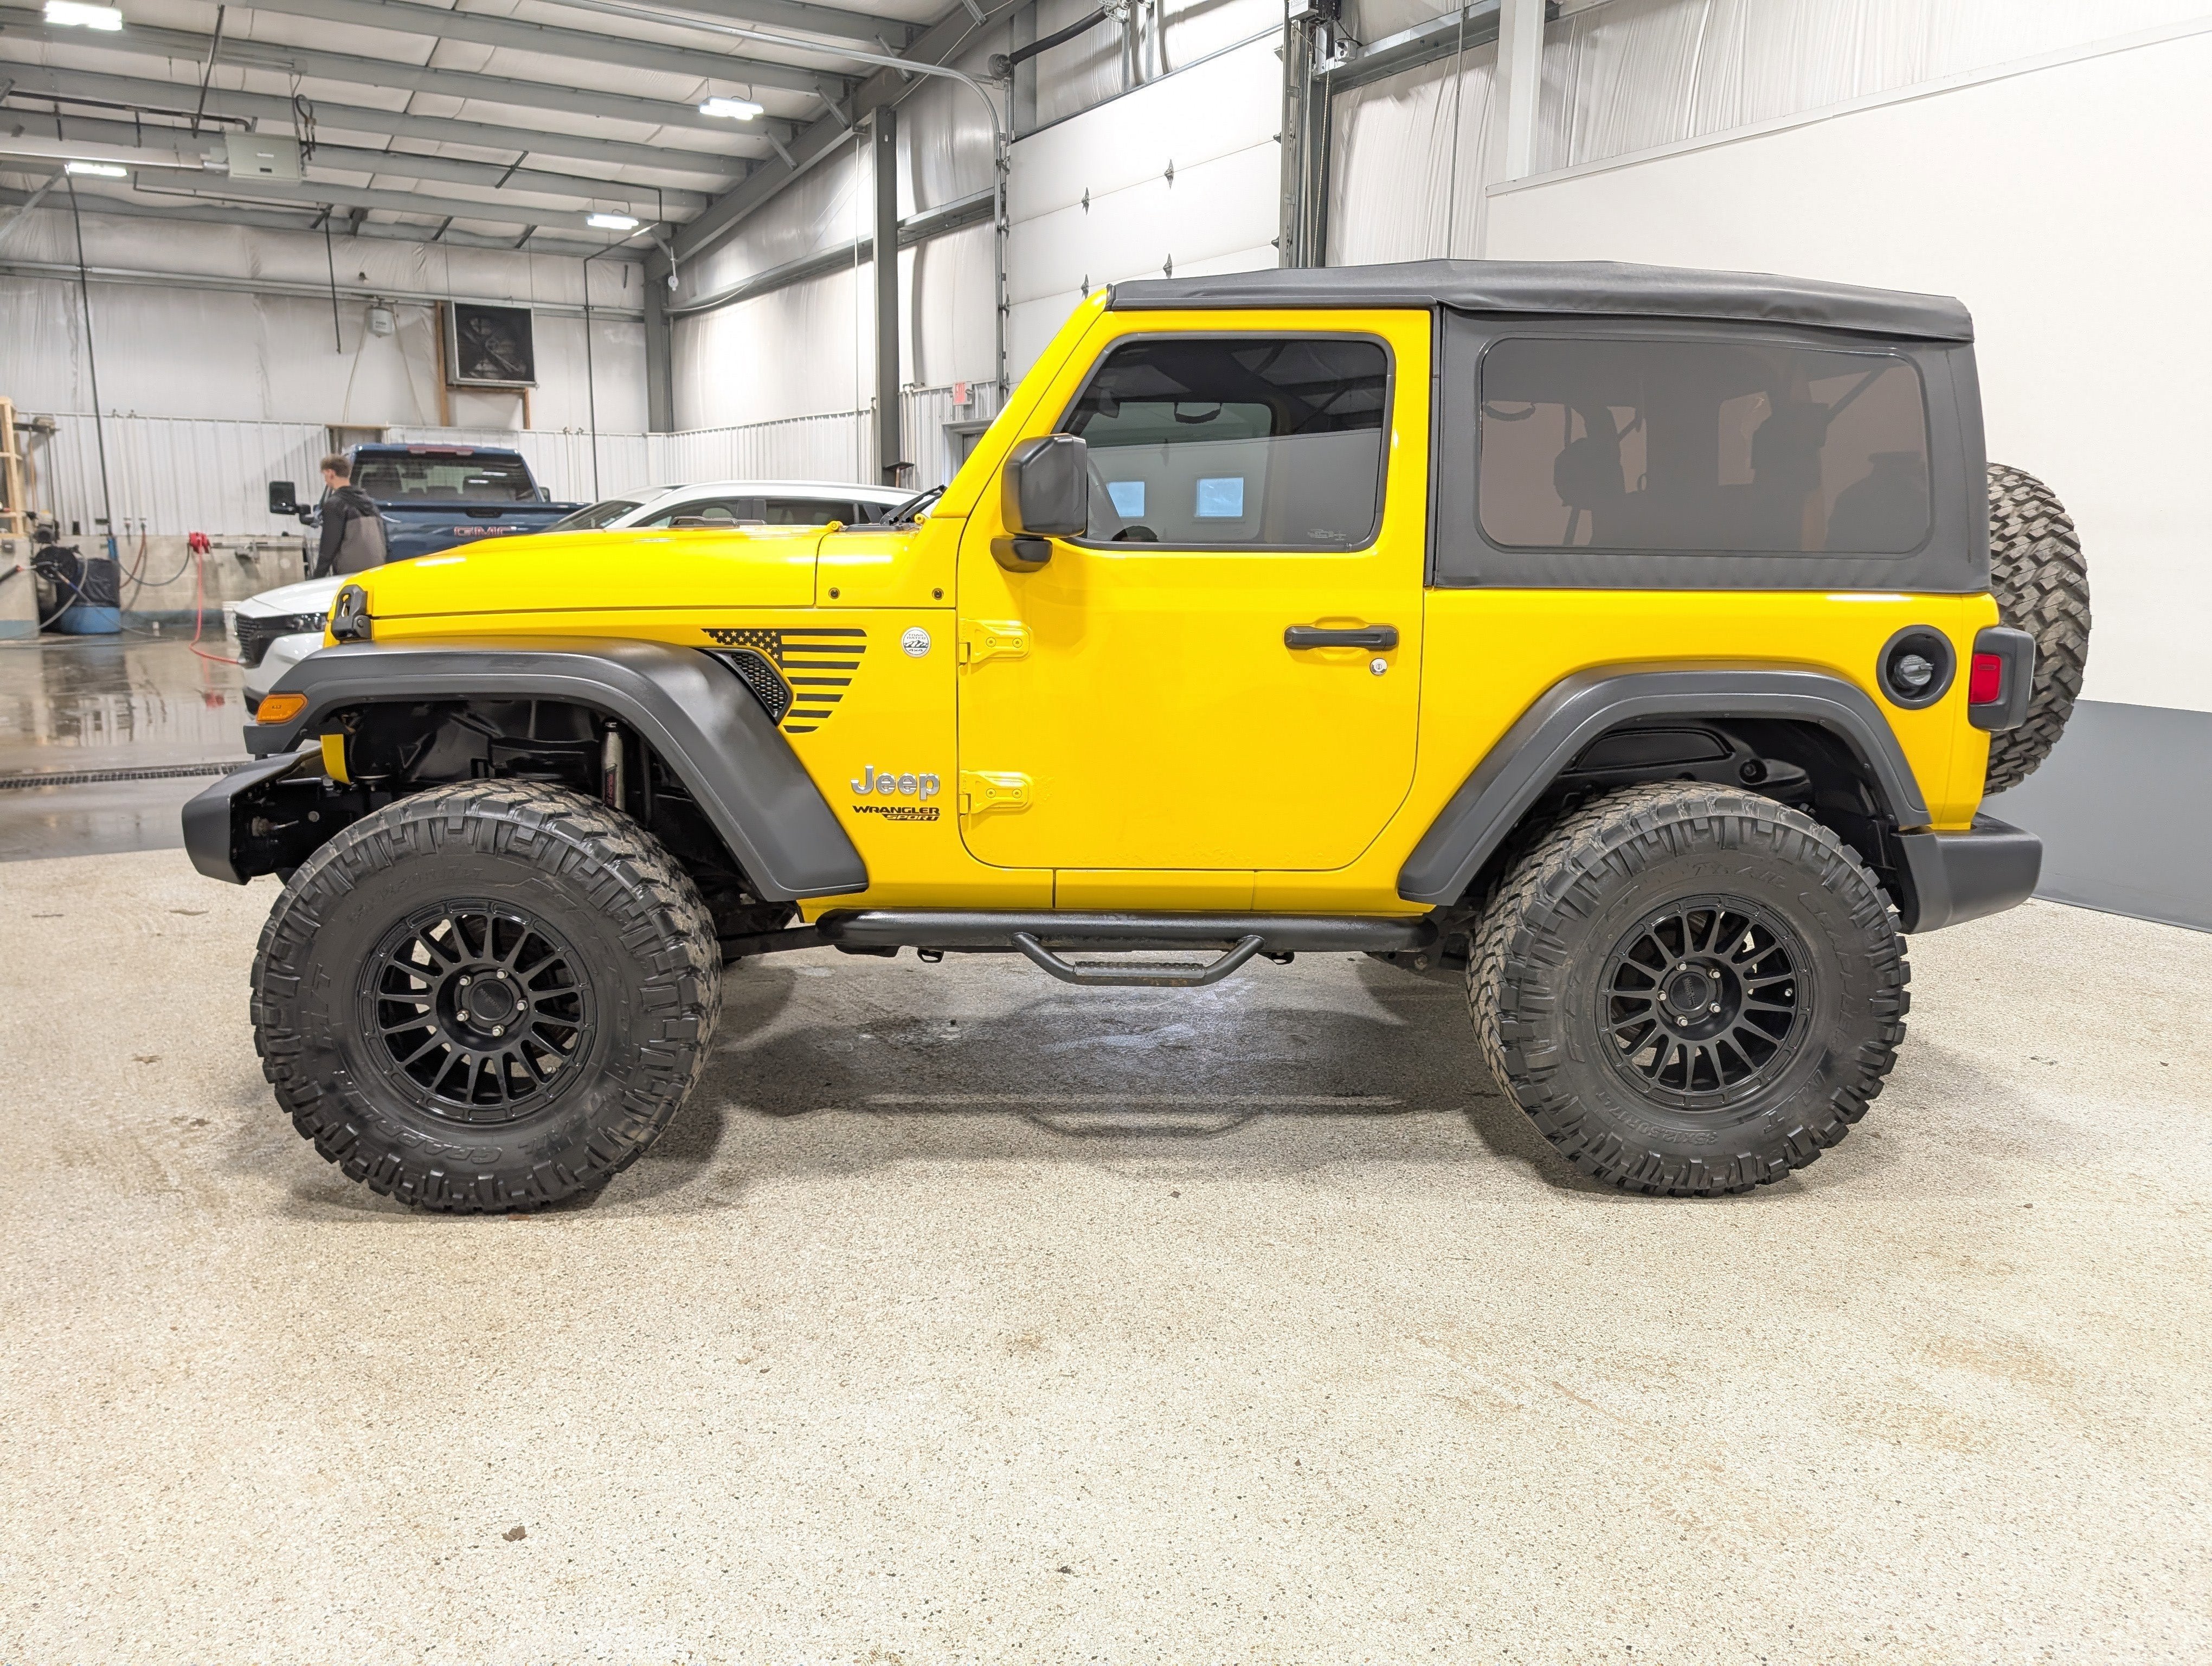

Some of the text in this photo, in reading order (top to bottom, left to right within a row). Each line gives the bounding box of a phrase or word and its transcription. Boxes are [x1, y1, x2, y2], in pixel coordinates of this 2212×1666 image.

[454, 526, 517, 537] GMC
[850, 765, 941, 801] Jeep
[852, 805, 940, 814] WRANGLER
